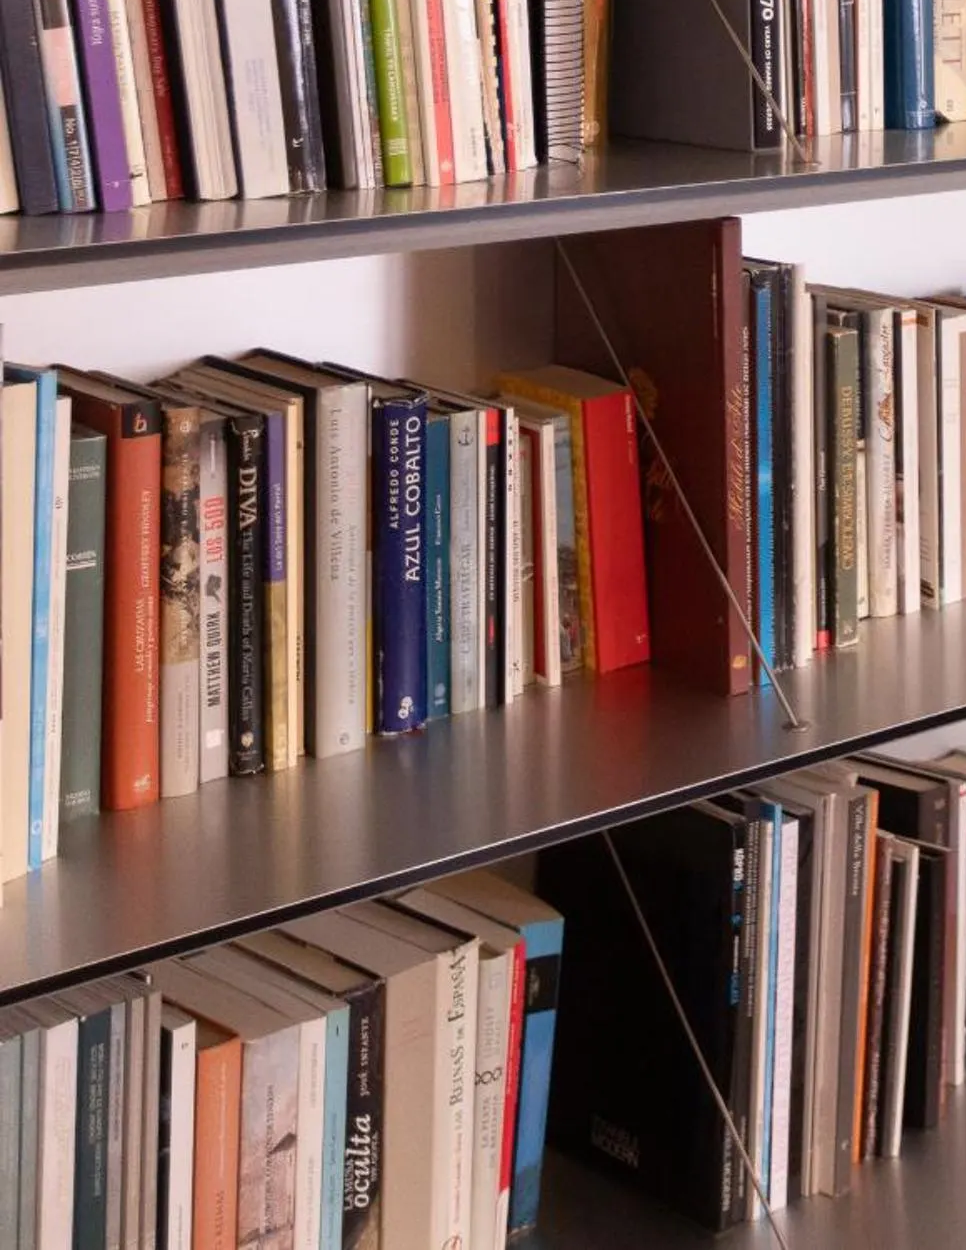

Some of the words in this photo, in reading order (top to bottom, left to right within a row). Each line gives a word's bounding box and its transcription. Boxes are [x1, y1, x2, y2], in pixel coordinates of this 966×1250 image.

[331, 408, 342, 440] Luis
[390, 418, 399, 462] CONDE
[840, 386, 853, 456] DEBUSSY
[331, 446, 342, 502] Antonio
[404, 416, 421, 516] COBALTO
[203, 498, 225, 530] 500
[238, 465, 258, 530] DIVA
[331, 508, 342, 524] de
[389, 468, 399, 528] ALFREDO
[205, 536, 224, 564] LOS
[241, 553, 253, 576] Life
[331, 530, 342, 580] Villena
[404, 522, 420, 582] AZUL
[241, 578, 252, 598] and
[205, 612, 222, 648] QUIRK
[241, 602, 252, 634] Death
[204, 652, 221, 707] MATTHEW
[446, 956, 467, 1022] ESPAÑA
[360, 1016, 370, 1066] INFANTE
[359, 1070, 369, 1096] JOSÉ
[449, 1044, 465, 1105] REINAS
[343, 1158, 354, 1192] MUSA
[346, 1113, 371, 1208] oculta
[343, 1194, 353, 1210] LA
